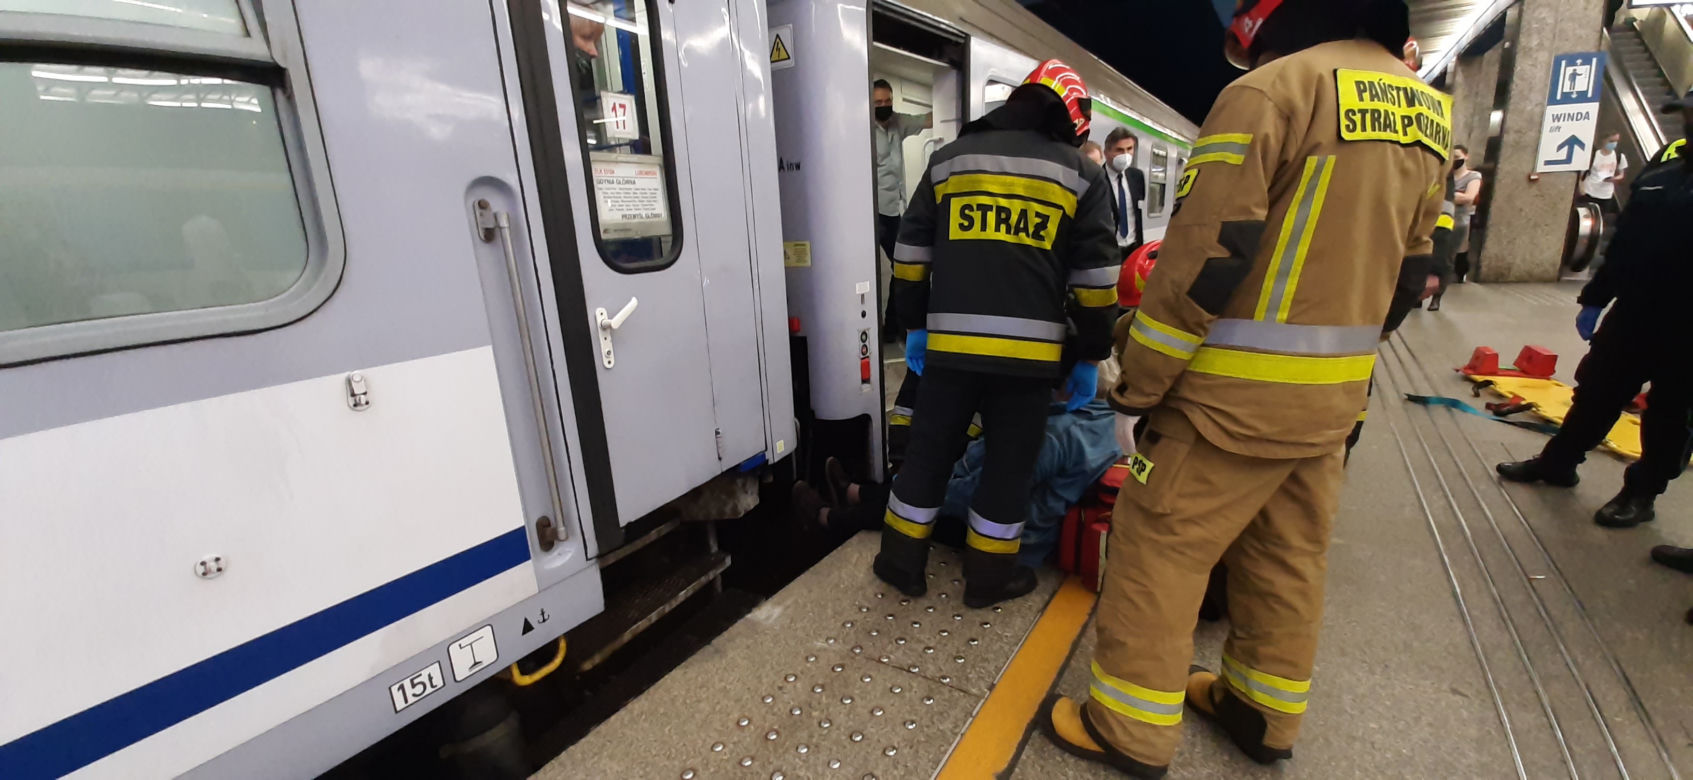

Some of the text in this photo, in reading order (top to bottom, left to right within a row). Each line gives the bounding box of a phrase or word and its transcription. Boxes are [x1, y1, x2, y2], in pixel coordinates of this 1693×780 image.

[611, 102, 627, 130] 17
[1551, 111, 1590, 123] WINDA
[1131, 456, 1147, 477] PSP
